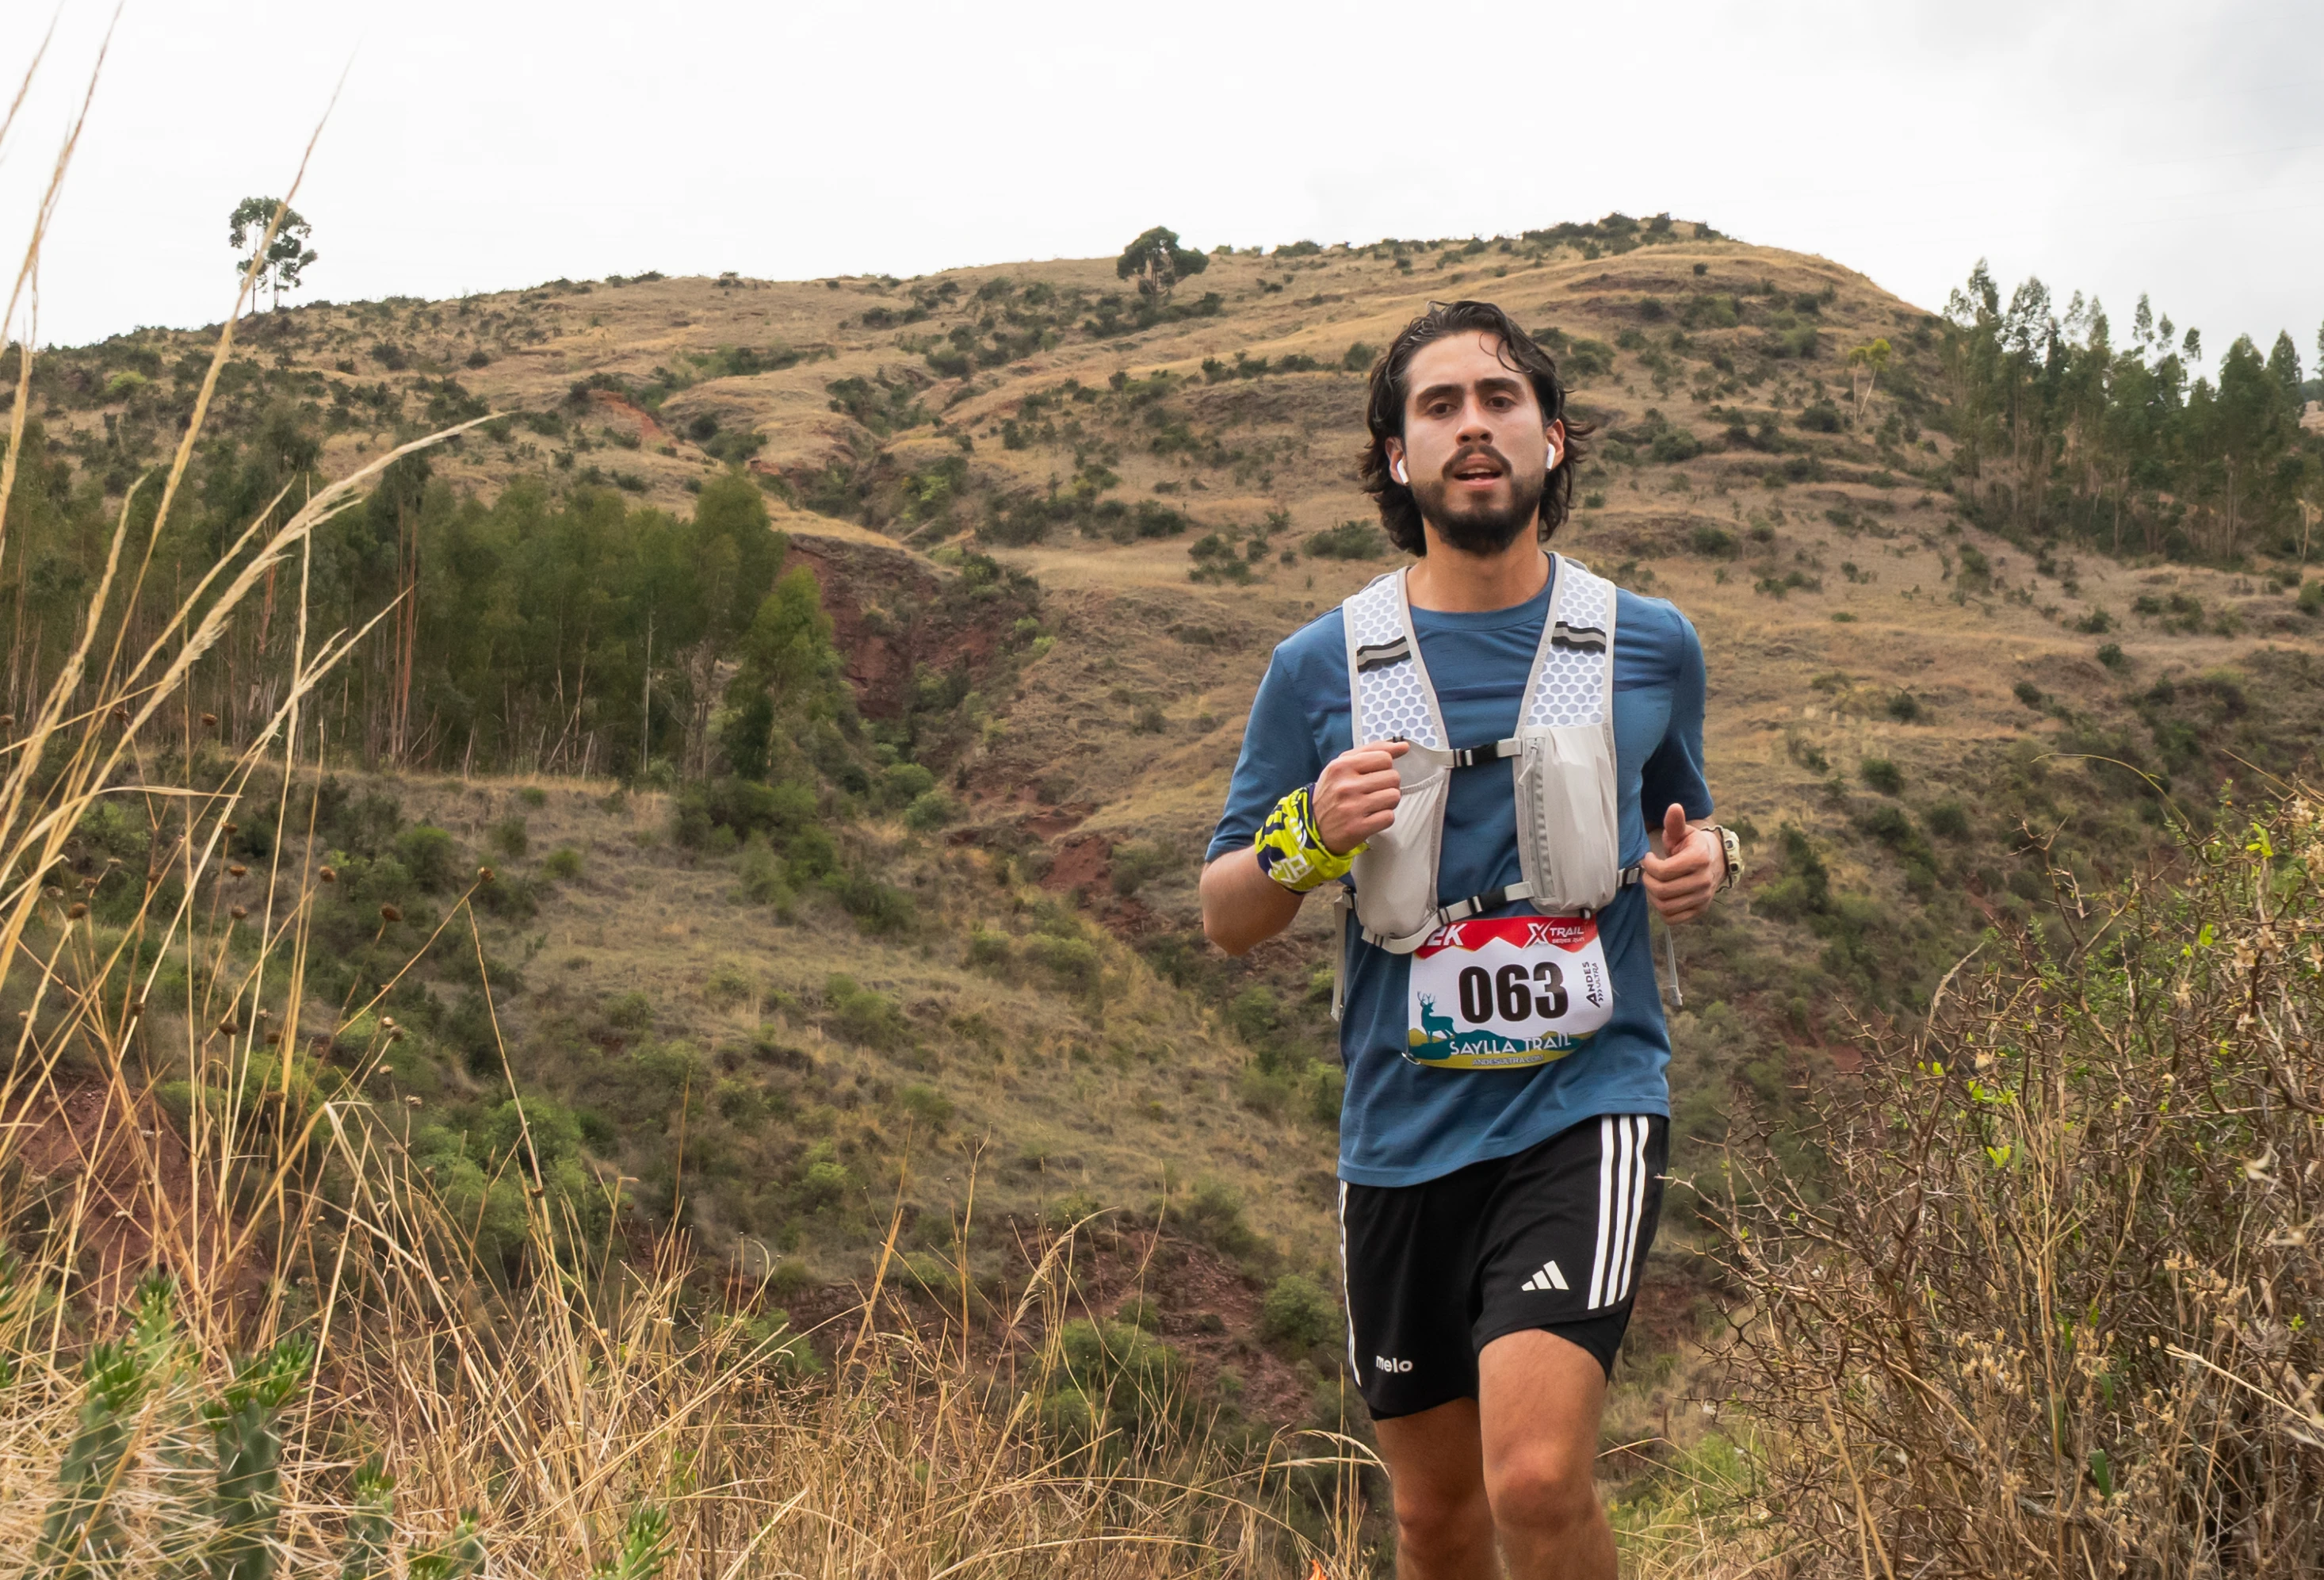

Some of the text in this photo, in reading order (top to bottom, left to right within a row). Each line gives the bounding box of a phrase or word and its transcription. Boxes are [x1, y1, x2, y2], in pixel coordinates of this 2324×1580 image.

[1522, 920, 1584, 949] X TRAIL
[1582, 962, 1600, 1008] ANDES
[1592, 962, 1601, 989] ULTRA
[1458, 962, 1569, 1023] 063
[1450, 1032, 1572, 1055] SAYLLA TRAIL
[1376, 1355, 1413, 1373] melo
